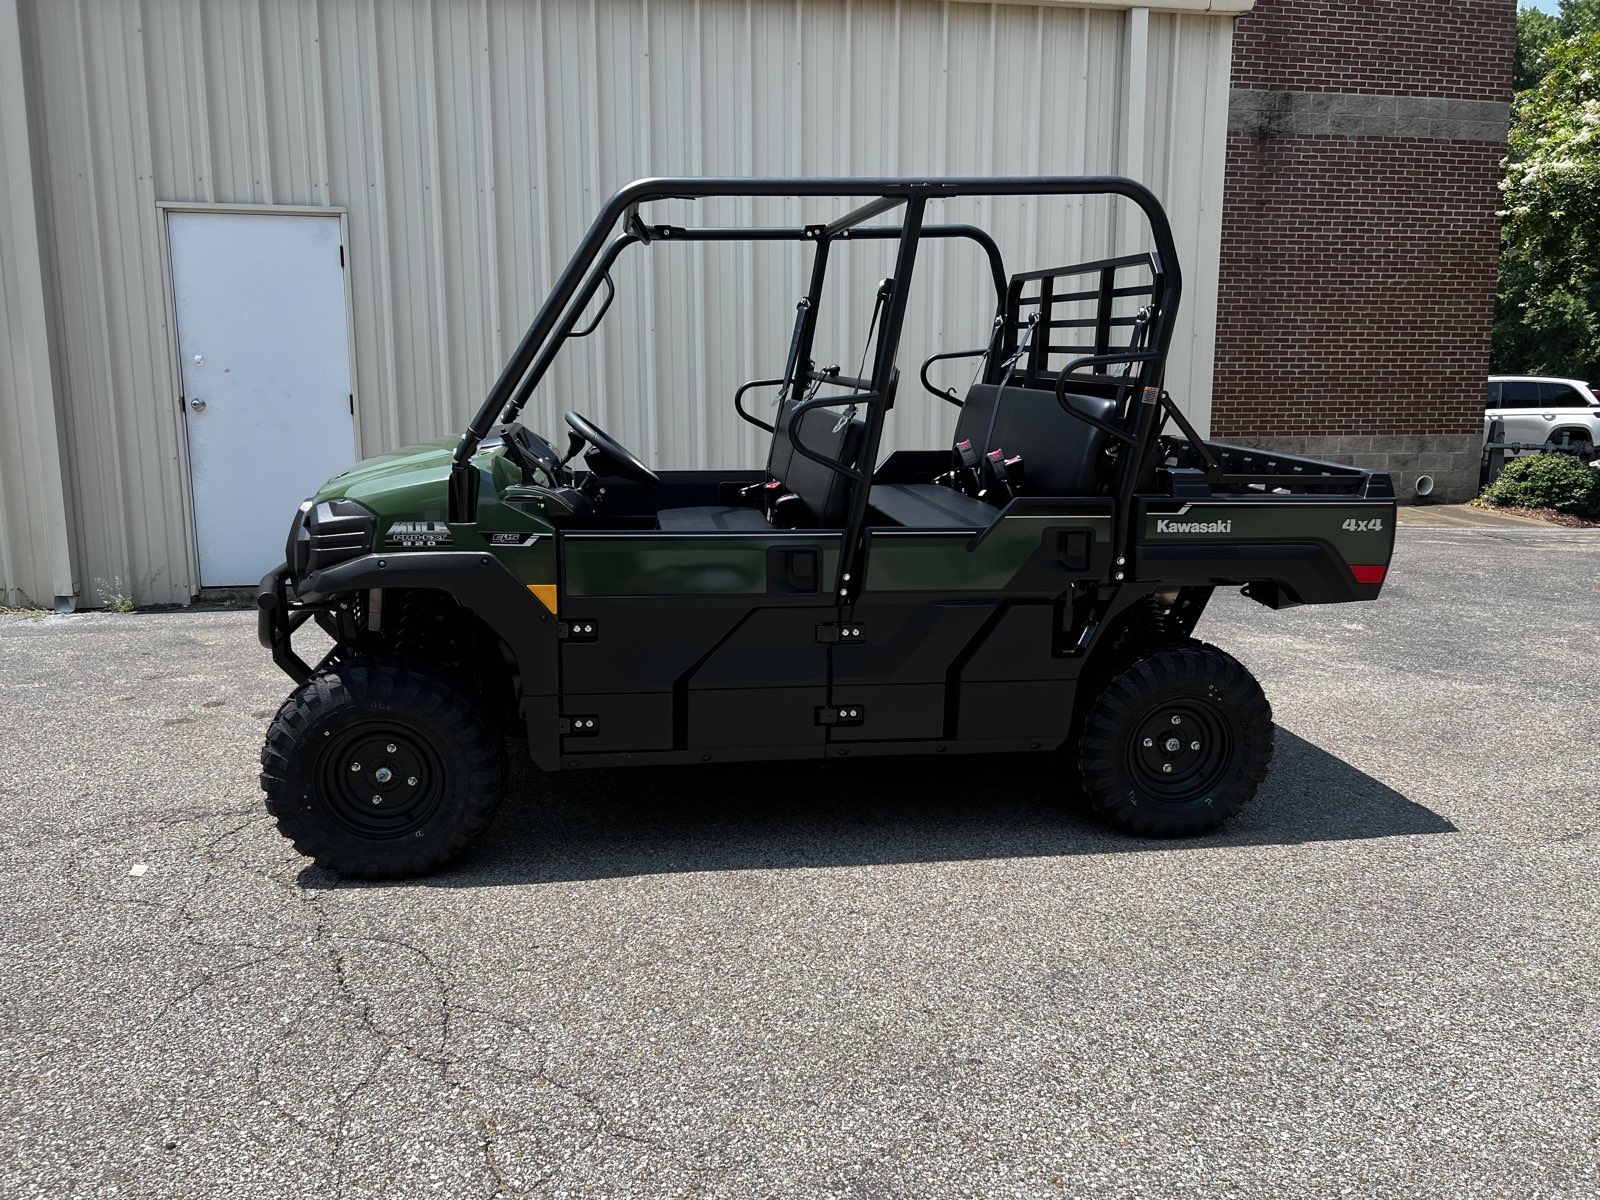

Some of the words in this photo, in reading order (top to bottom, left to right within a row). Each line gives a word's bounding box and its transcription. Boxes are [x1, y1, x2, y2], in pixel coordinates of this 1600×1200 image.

[385, 521, 452, 535] MULE
[1156, 519, 1231, 533] Kawasaki
[1342, 519, 1383, 532] 4x4
